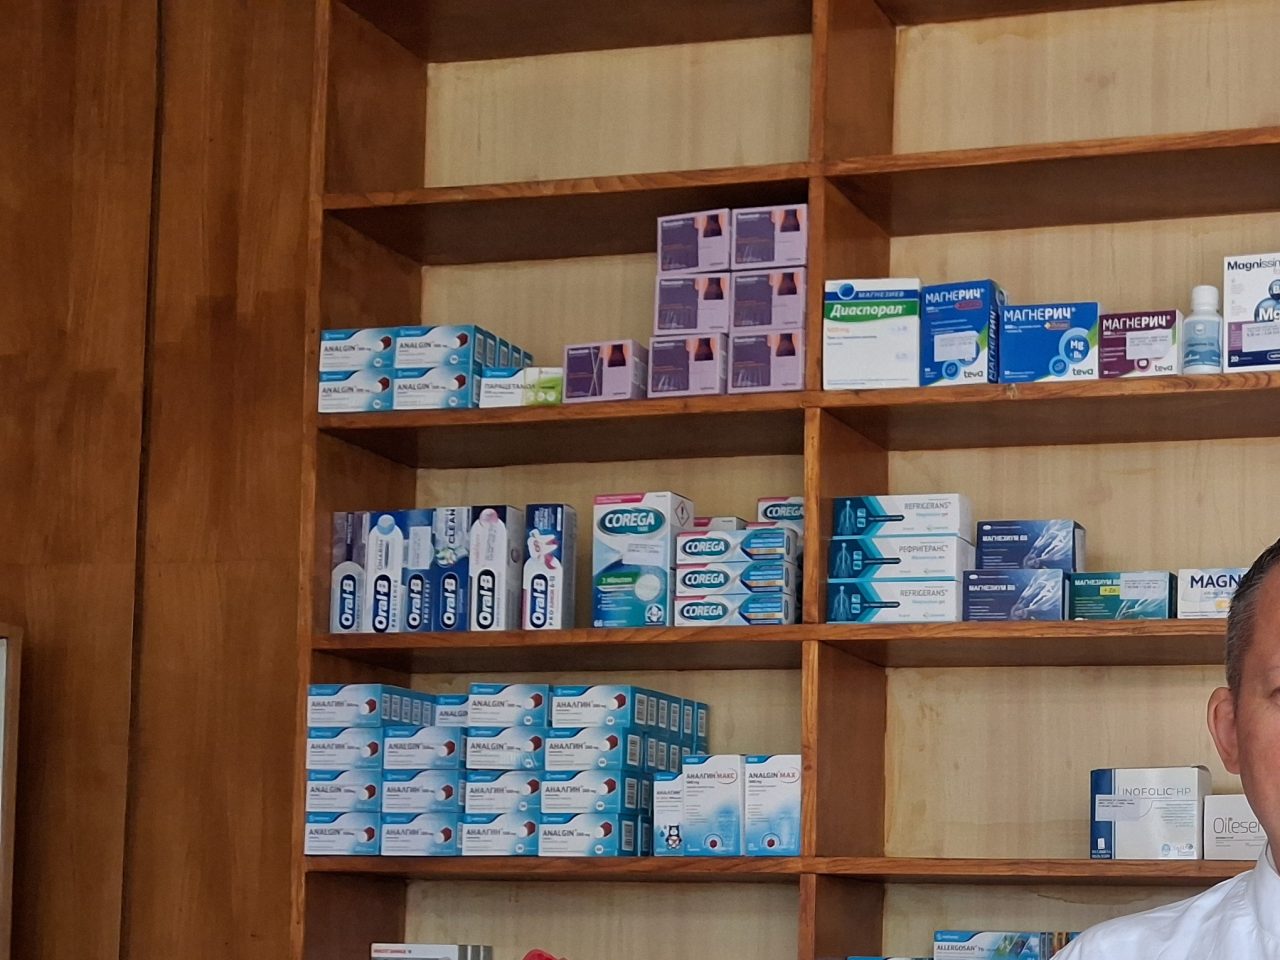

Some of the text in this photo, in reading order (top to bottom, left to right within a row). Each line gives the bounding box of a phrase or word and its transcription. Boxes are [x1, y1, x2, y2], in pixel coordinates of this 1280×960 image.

[925, 289, 981, 304] МАГНЕРИЧ
[830, 304, 902, 318] Диаспорал
[1004, 307, 1072, 322] МАГНЕРИЧ
[1102, 315, 1167, 330] МАГНЕРИЧ
[963, 370, 983, 378] teva
[1072, 368, 1094, 376] teva
[1154, 364, 1173, 372] teva
[604, 513, 655, 527] COREGA
[685, 541, 725, 552] COREGA
[685, 573, 724, 584] COREGA
[1190, 574, 1242, 588] MAGN
[342, 580, 355, 626] Oral-B
[374, 580, 390, 630] Oral-B
[409, 578, 422, 626] Oral-B
[443, 578, 456, 625] Oral-B
[479, 575, 493, 625] Oral-B
[532, 578, 546, 625] Oral-B
[683, 605, 723, 616] COREGA
[1122, 787, 1174, 796] INOFOLIC
